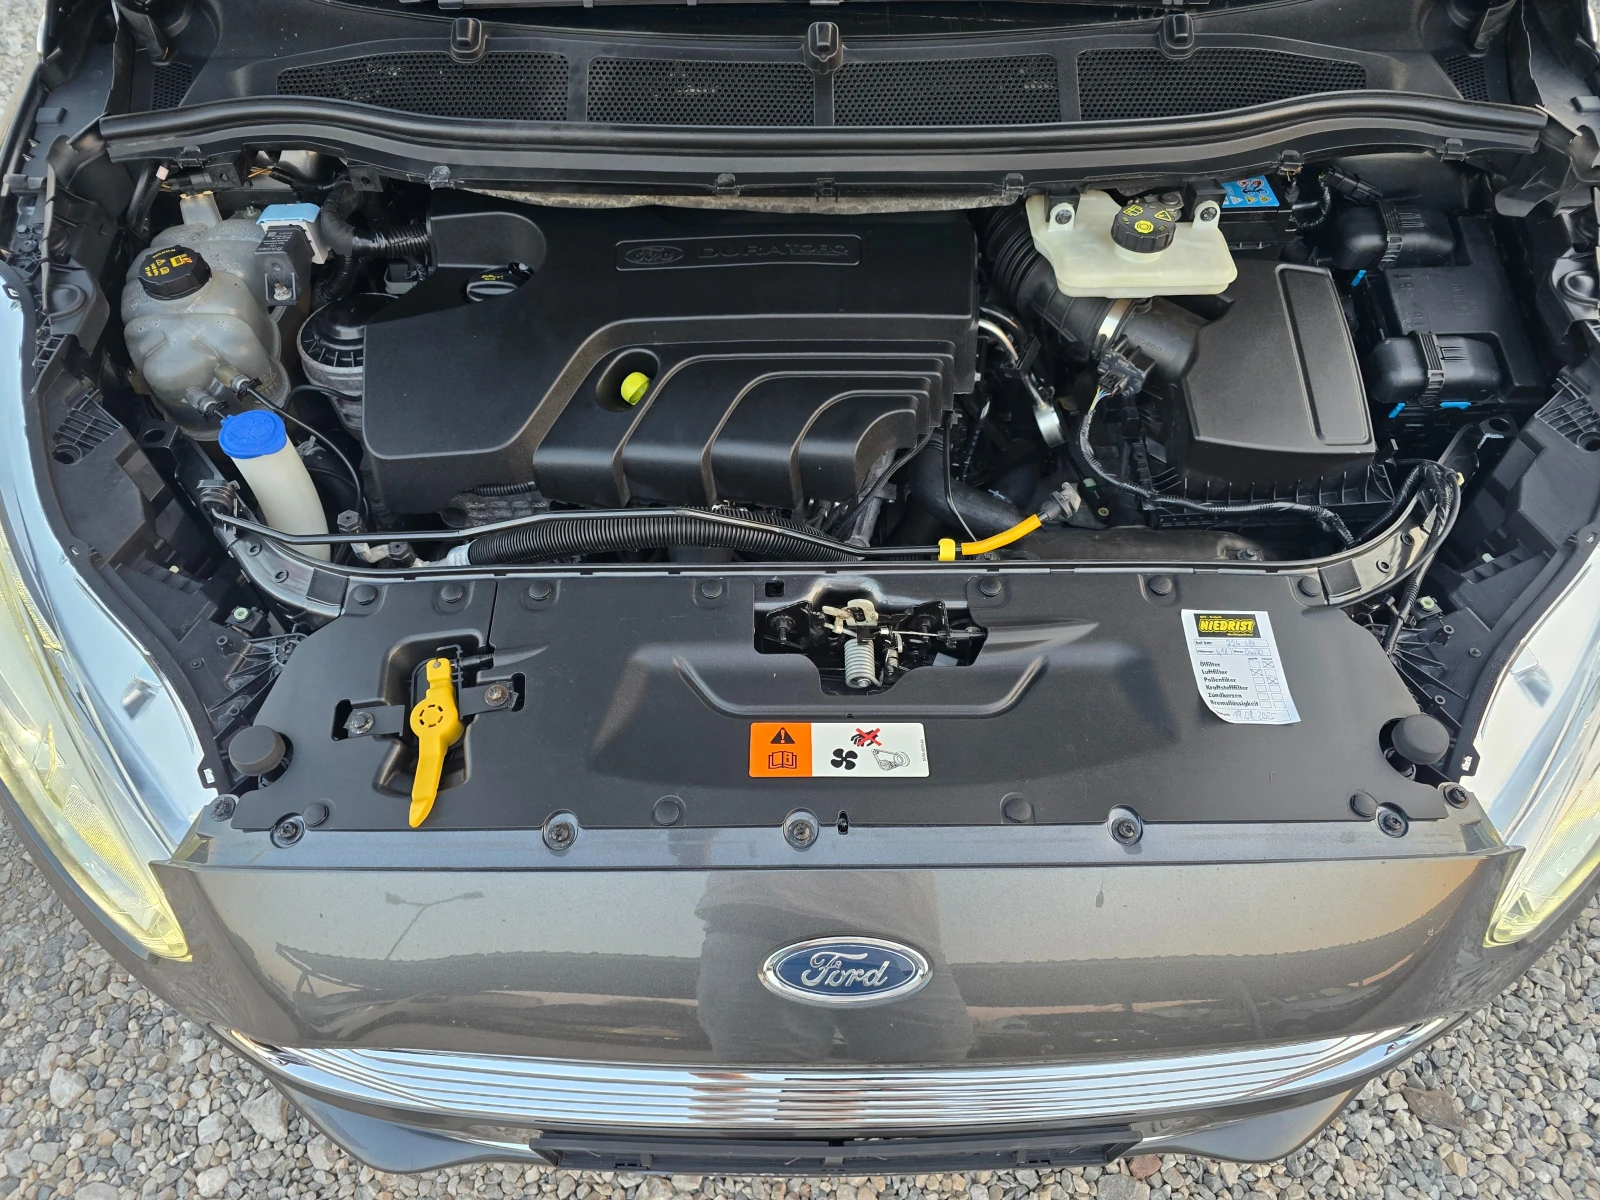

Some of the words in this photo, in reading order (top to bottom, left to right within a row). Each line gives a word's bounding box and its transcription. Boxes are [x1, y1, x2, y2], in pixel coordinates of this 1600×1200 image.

[633, 247, 676, 262] Ford
[1199, 619, 1255, 633] NIEDRIST
[1210, 699, 1259, 708] Bremsflüssigkeit
[801, 951, 890, 987] Ford
